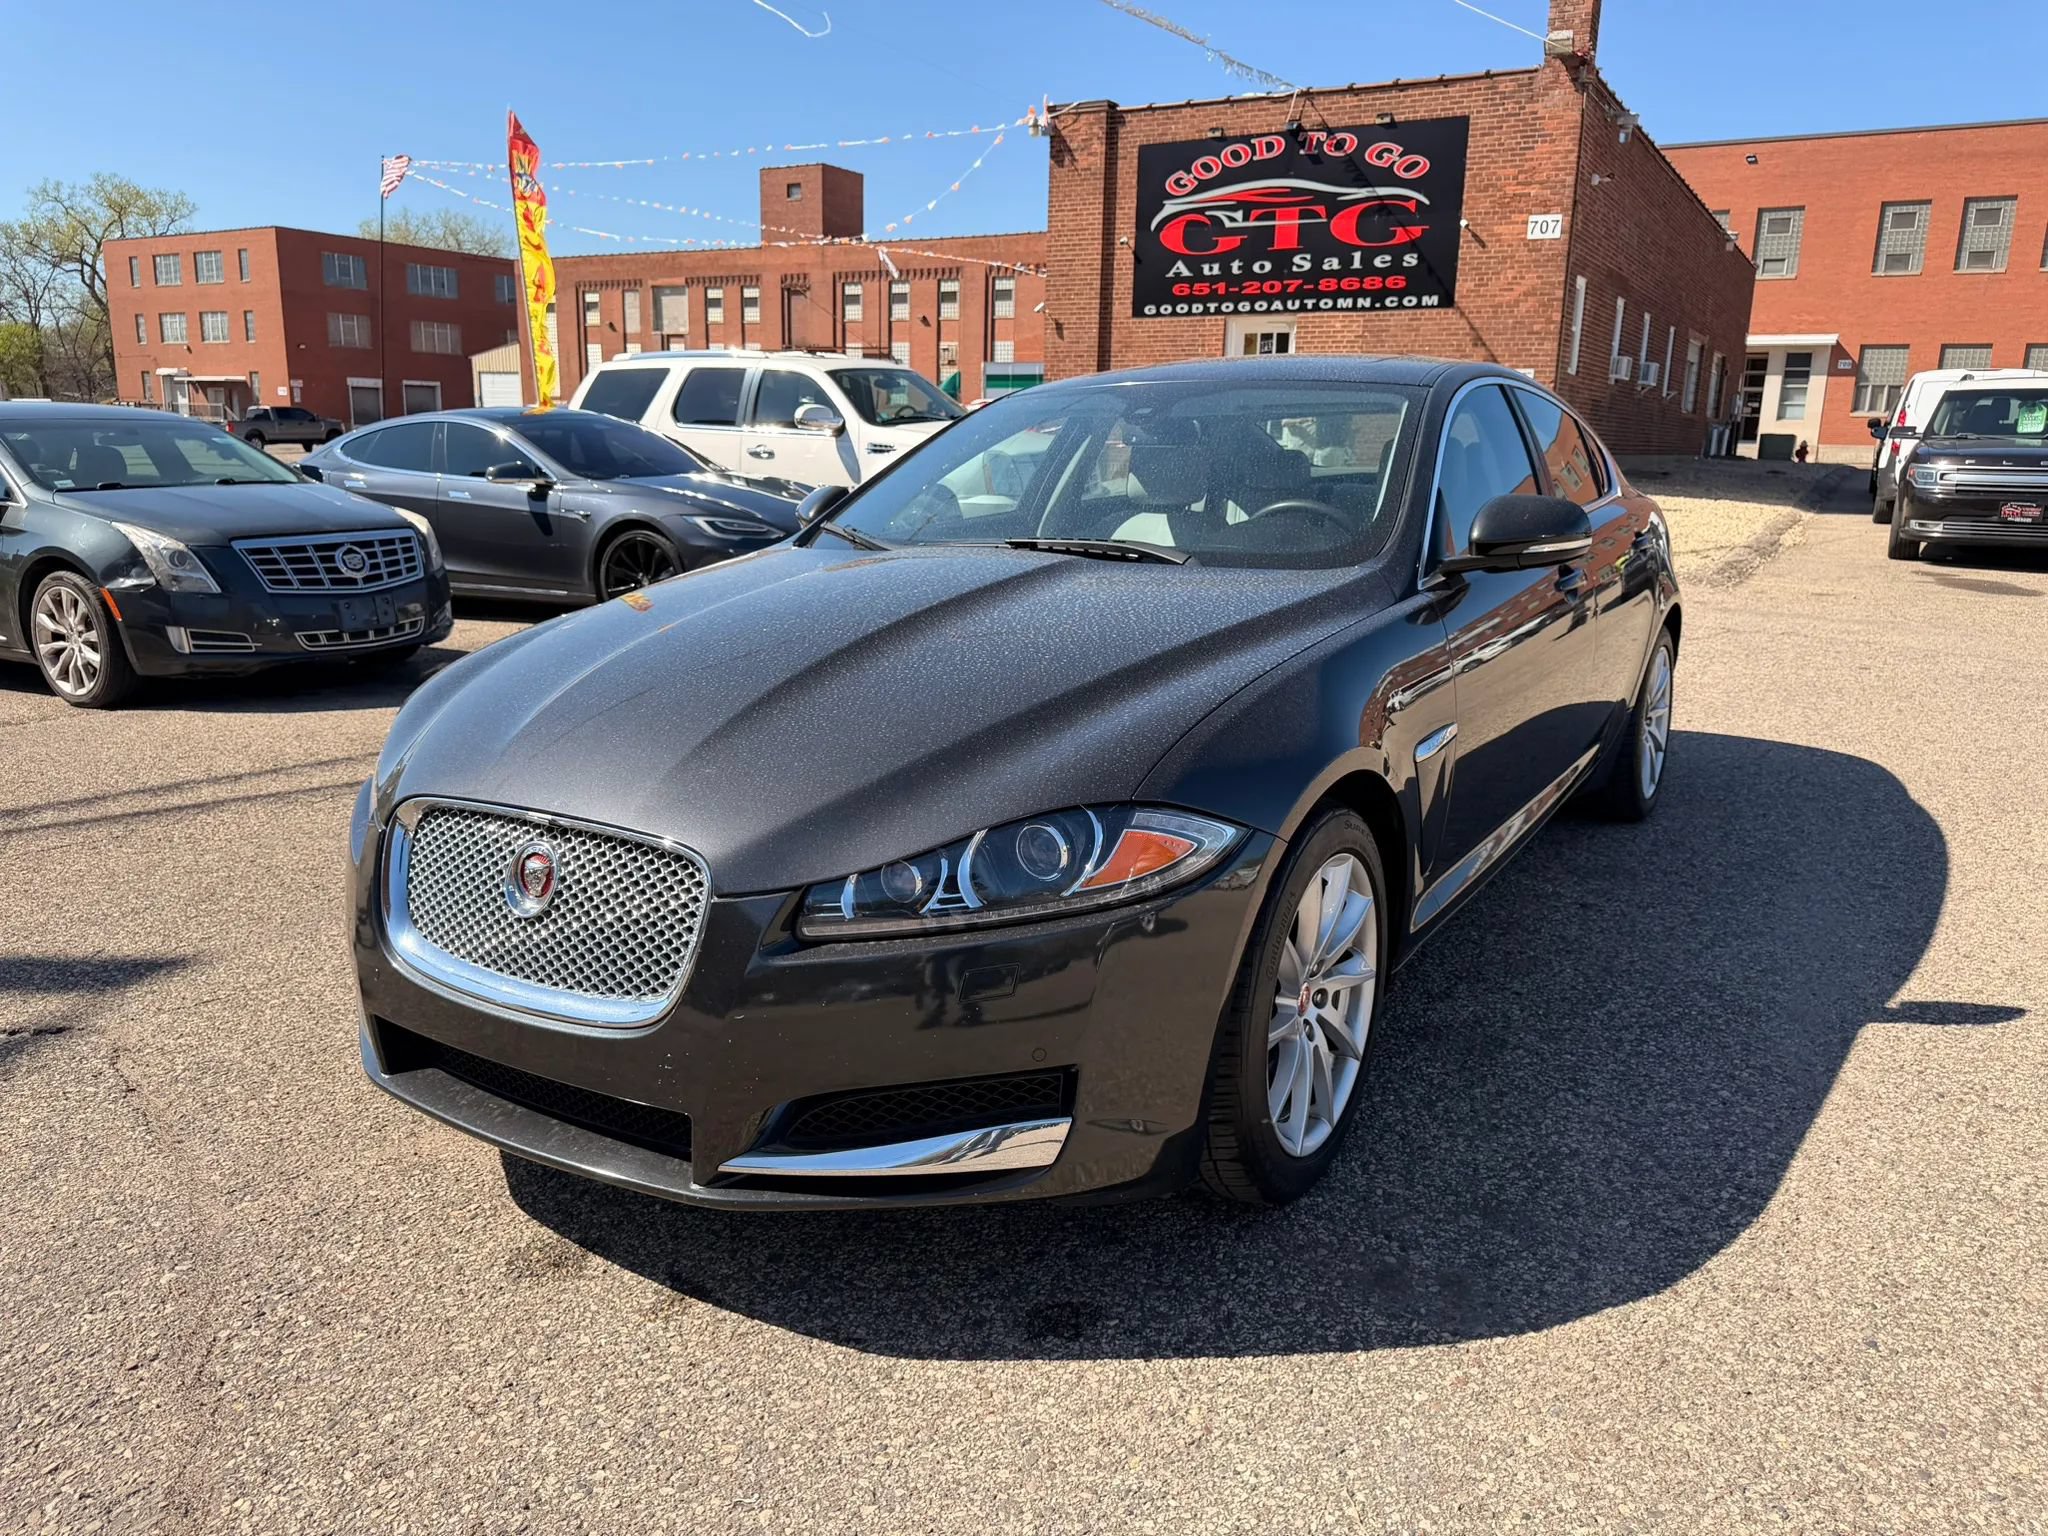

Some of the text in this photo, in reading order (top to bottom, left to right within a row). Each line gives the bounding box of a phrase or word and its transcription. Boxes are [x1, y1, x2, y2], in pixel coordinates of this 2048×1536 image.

[1165, 132, 1430, 196] GOOD TO GO
[1159, 200, 1430, 255] GTG
[1530, 220, 1560, 235] 707
[1165, 251, 1419, 278] Auto Sales
[1171, 276, 1407, 297] 651-207-8686
[1143, 295, 1440, 315] GOODTOGOAUTOMN.COM
